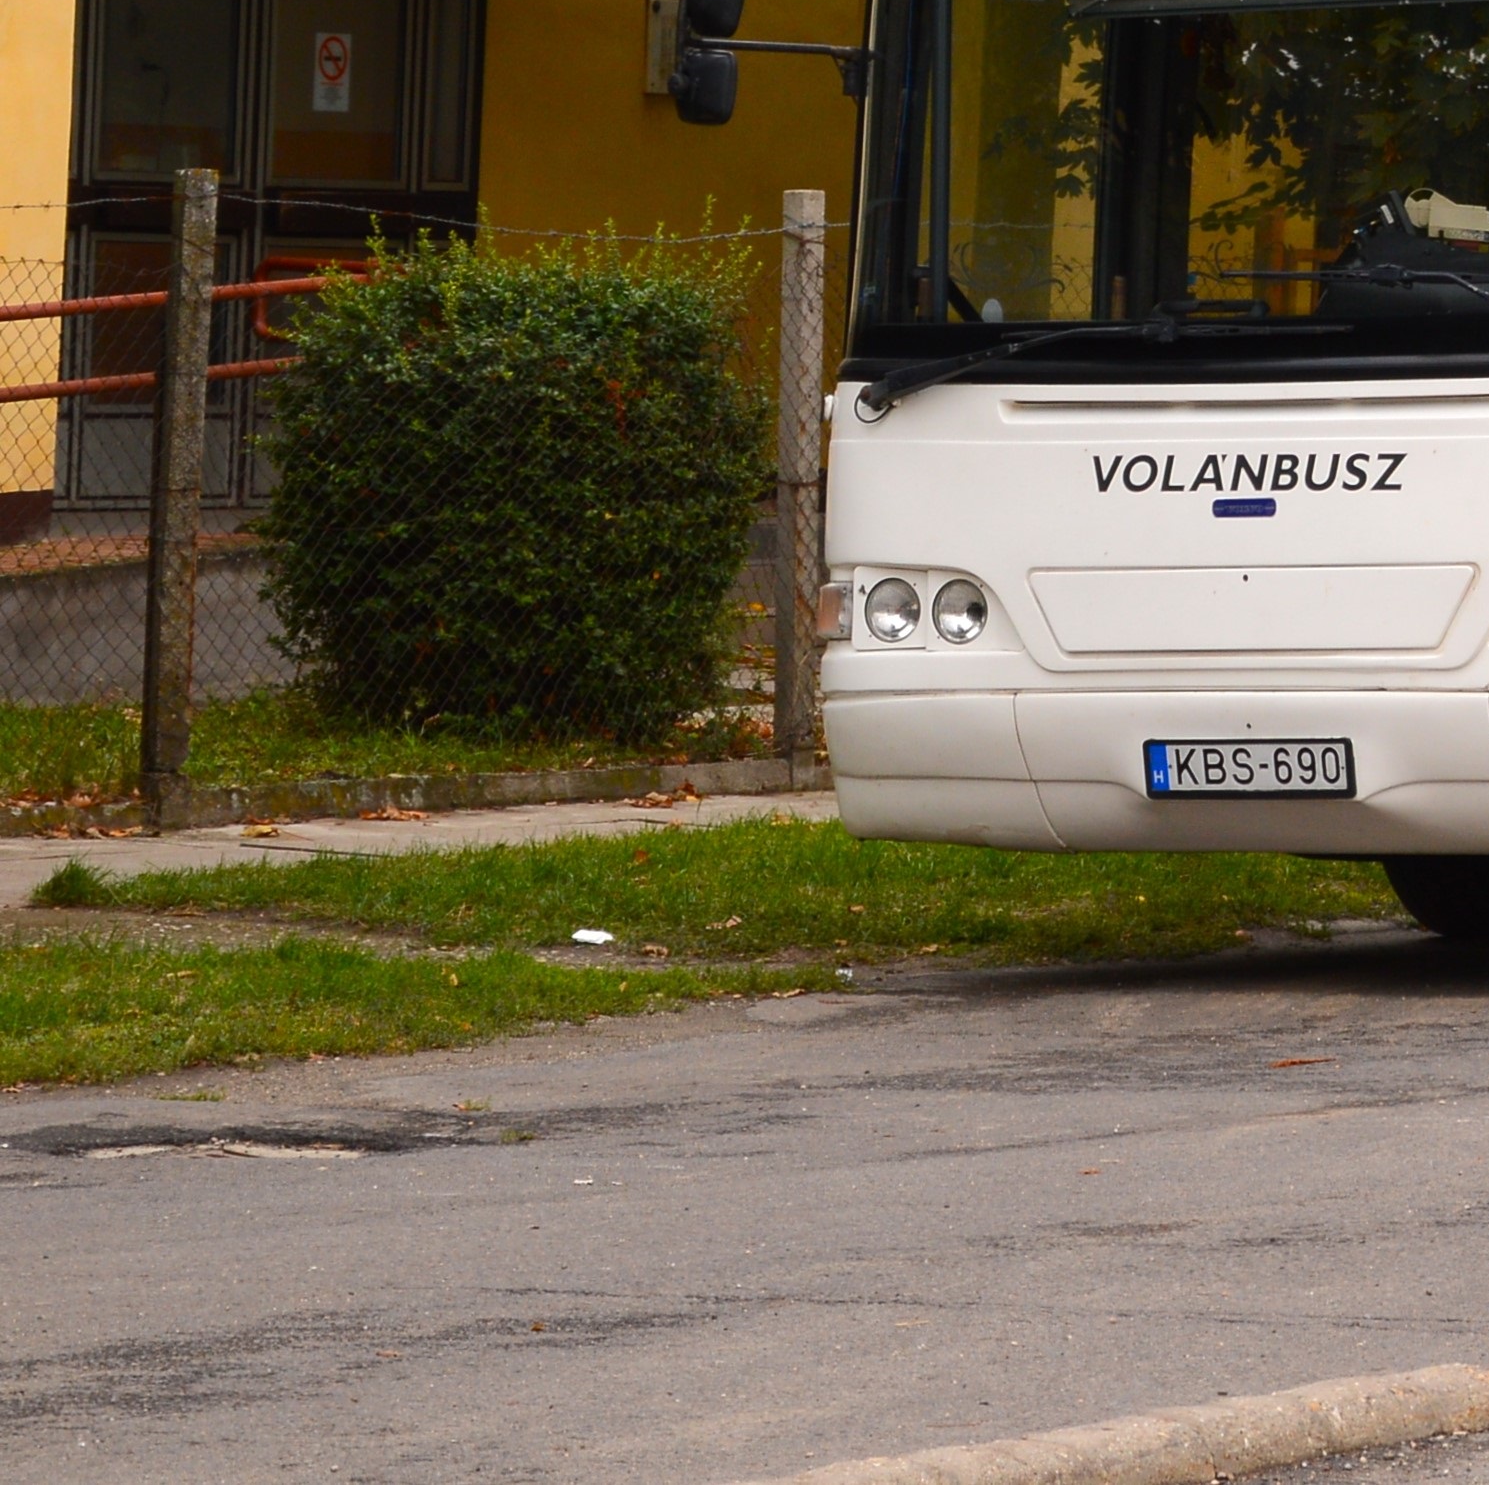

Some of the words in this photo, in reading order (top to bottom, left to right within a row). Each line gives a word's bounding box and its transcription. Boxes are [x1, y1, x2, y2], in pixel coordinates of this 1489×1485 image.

[1093, 453, 1408, 492] VOLÁNBUSZ
[1153, 770, 1164, 783] H
[1175, 747, 1341, 785] KBS-690
